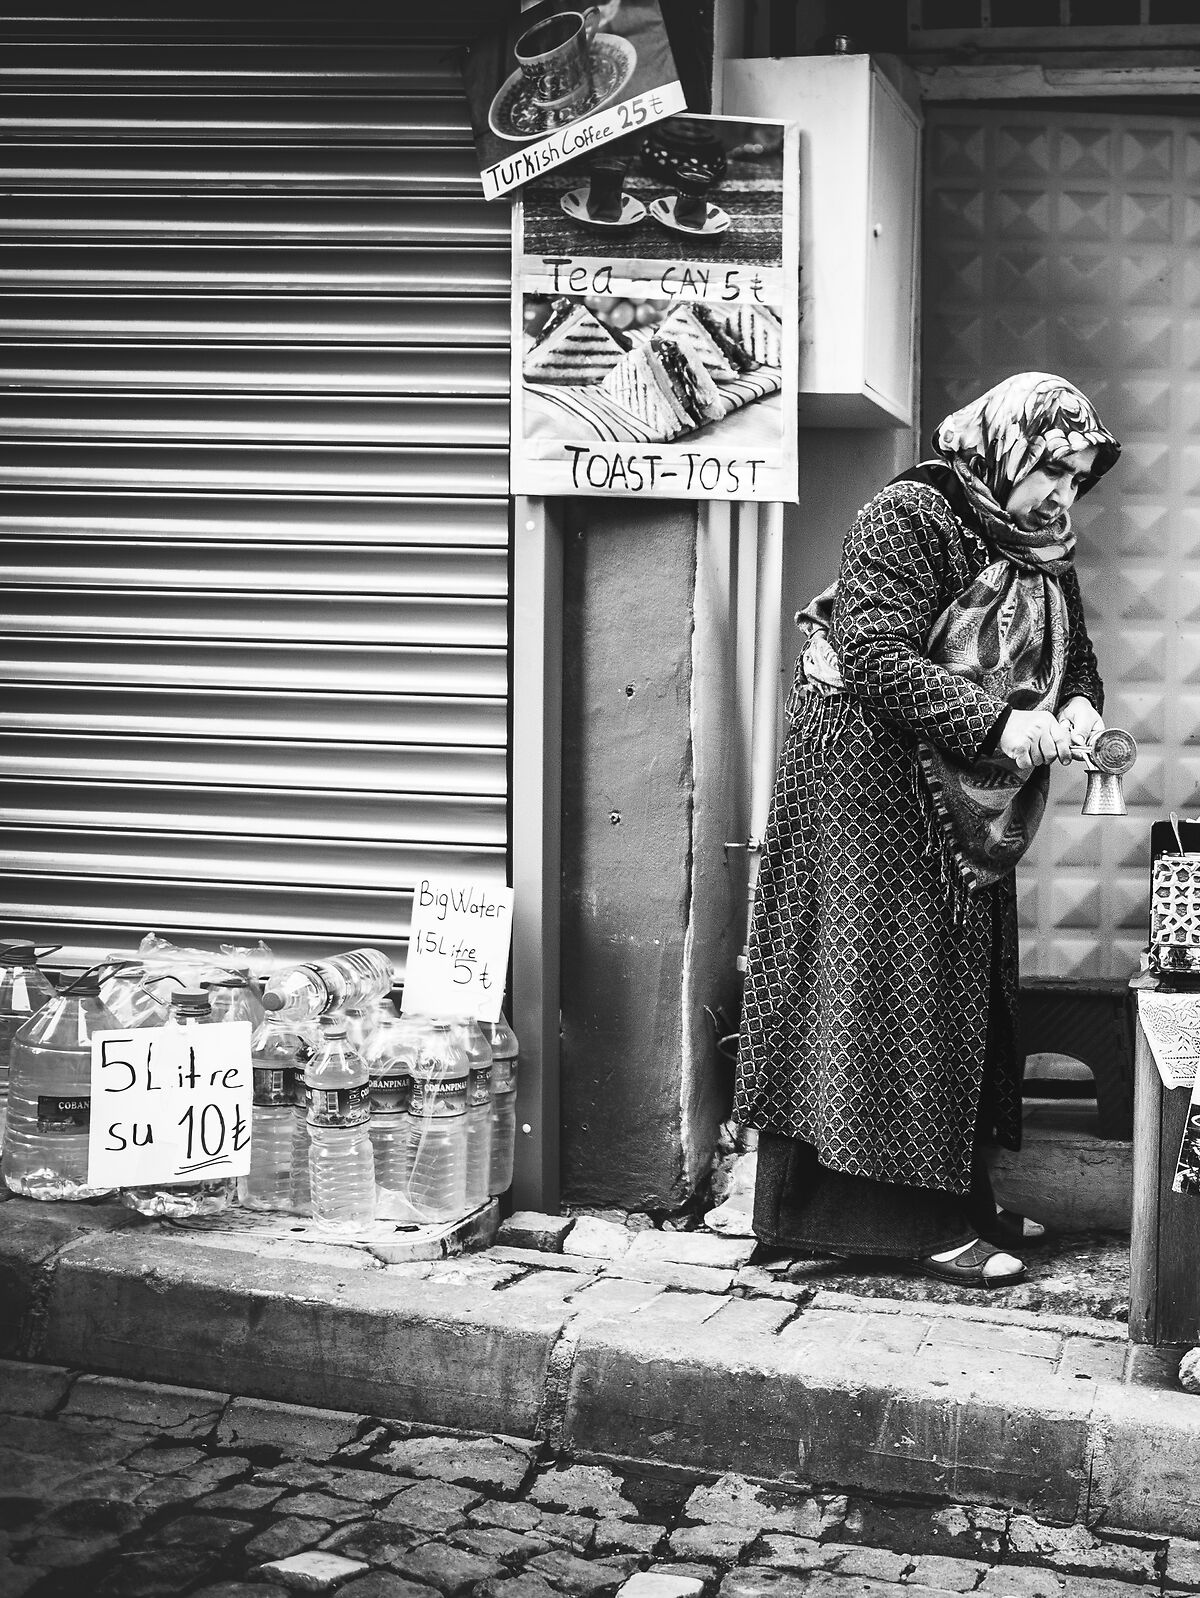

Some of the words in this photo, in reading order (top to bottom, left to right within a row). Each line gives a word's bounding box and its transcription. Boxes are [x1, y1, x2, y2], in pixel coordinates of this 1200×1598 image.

[487, 142, 560, 192] Turkish
[560, 125, 613, 156] Coffee
[542, 259, 613, 294] Tea
[419, 880, 448, 920] Big
[450, 888, 506, 919] Water
[105, 1122, 154, 1151] su
